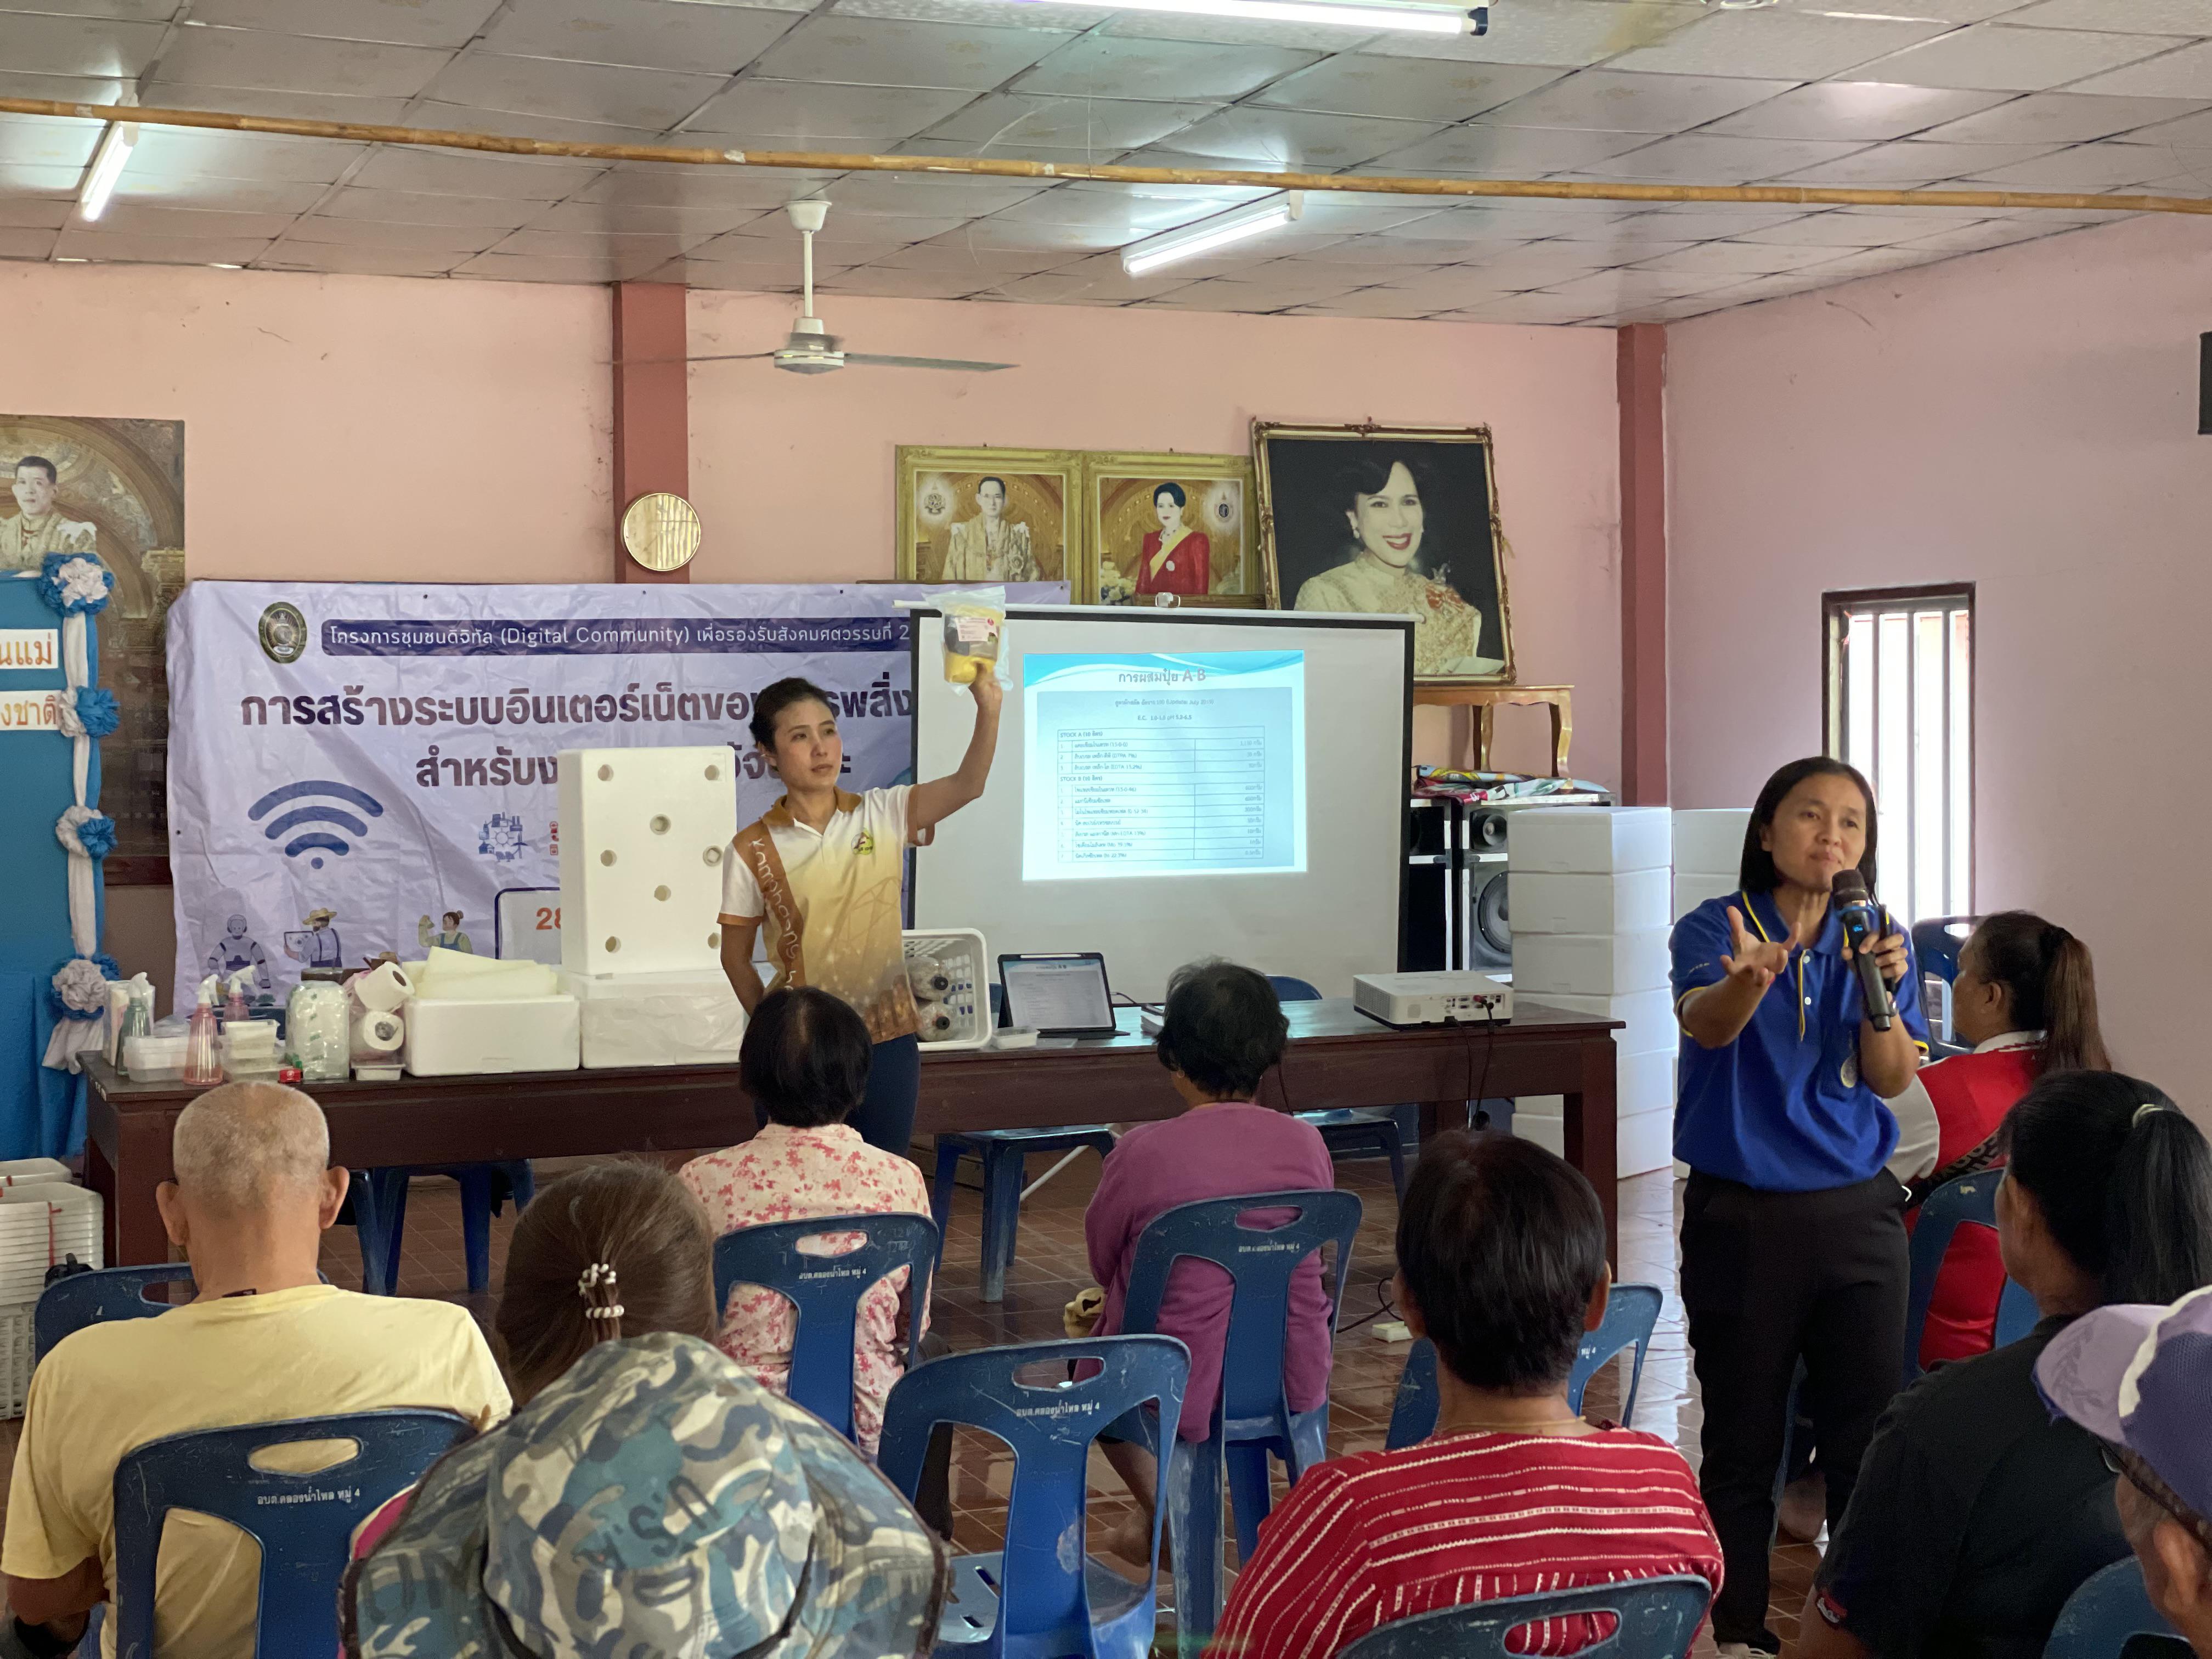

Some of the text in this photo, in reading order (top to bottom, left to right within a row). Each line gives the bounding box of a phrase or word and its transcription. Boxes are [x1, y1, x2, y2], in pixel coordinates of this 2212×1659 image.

[331, 627, 493, 648] โครงการชุมชนดิจิทัล
[500, 626, 568, 648] (Digital
[576, 627, 690, 646] Community)
[354, 1488, 360, 1497] 4
